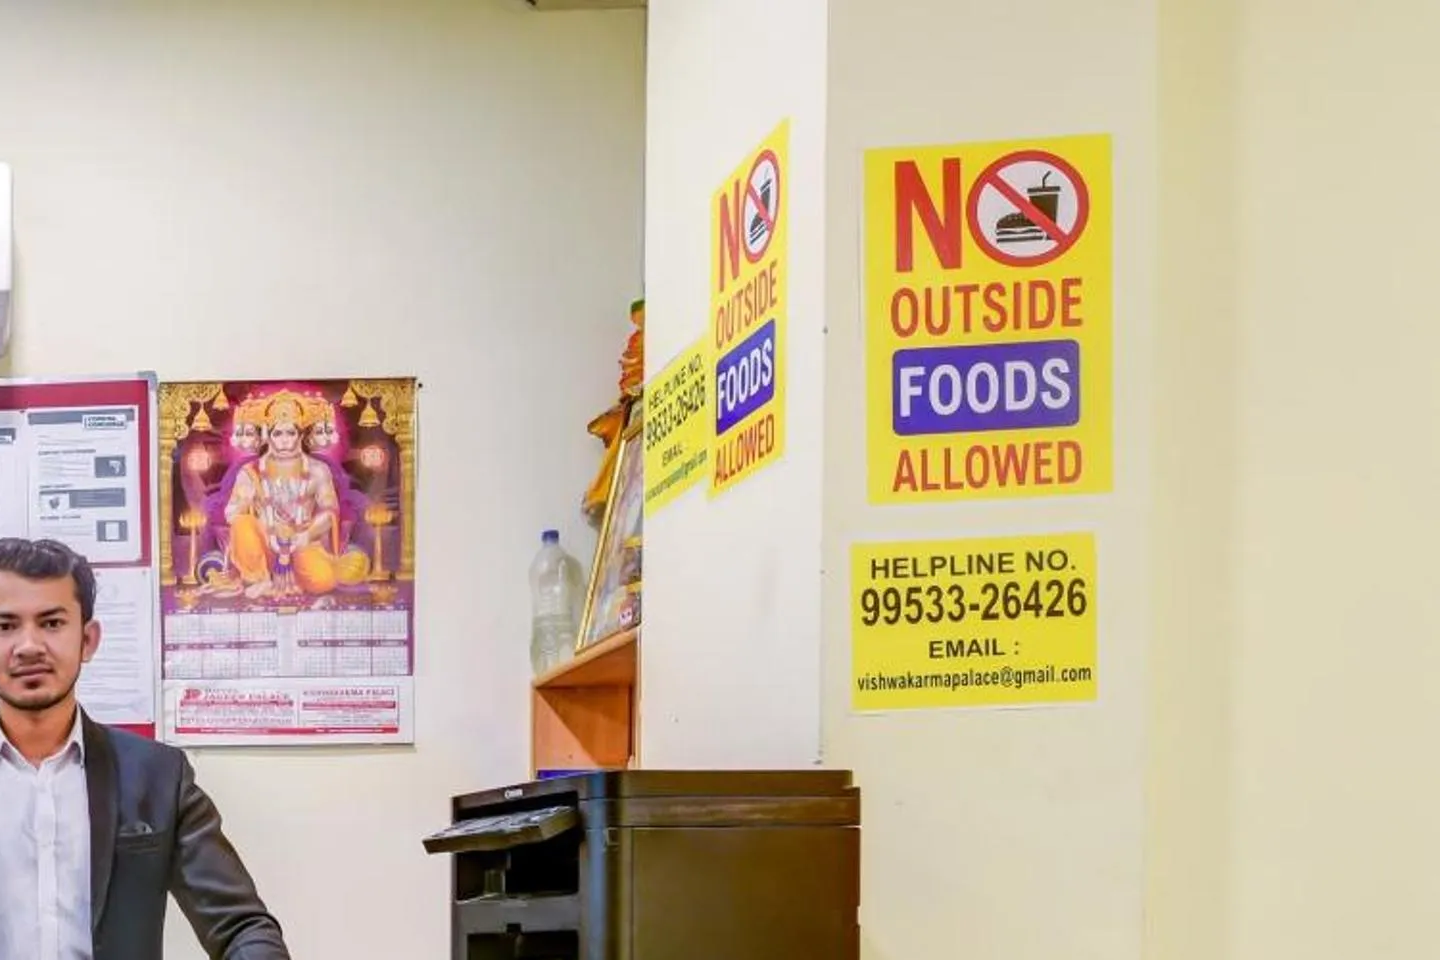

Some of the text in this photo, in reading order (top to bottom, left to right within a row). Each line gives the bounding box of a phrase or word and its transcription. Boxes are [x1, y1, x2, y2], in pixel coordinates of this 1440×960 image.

[715, 259, 779, 350] OUTSIDE
[891, 277, 1084, 338] OUTSIDE
[715, 337, 774, 420] FOODS
[899, 357, 1072, 418] FOODS
[714, 411, 775, 488] ALLOWED
[892, 439, 1084, 493] ALLOWED
[871, 549, 1077, 580] HELPLINE NO.
[861, 577, 1088, 627] 99533-26426
[928, 638, 1006, 659] EMAIL
[857, 664, 1092, 692] vishwakarmapalace@gmail.com
